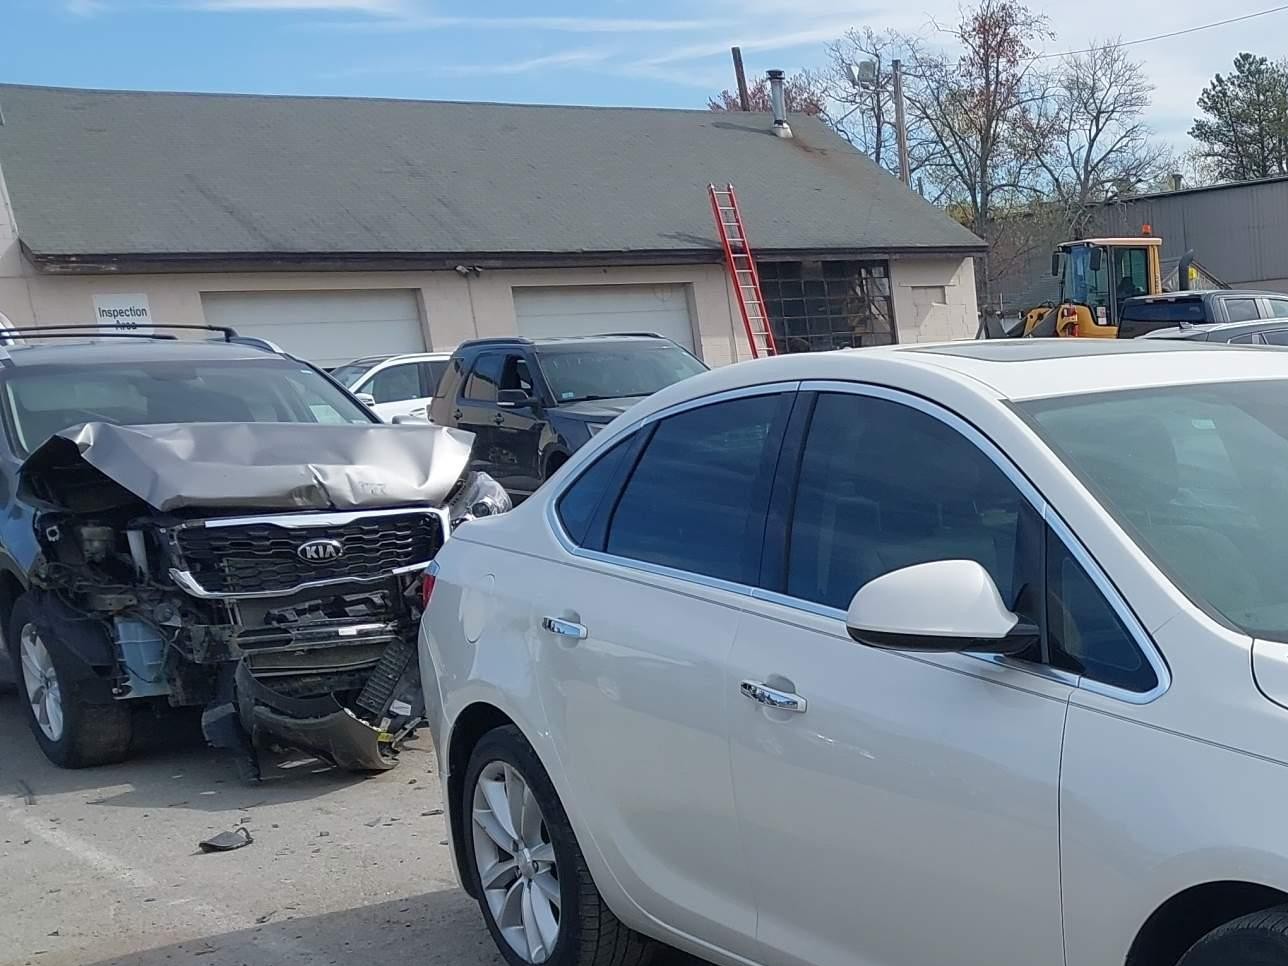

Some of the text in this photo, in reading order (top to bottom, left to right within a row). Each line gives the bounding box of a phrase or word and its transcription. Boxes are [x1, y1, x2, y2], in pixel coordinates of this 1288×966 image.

[98, 306, 148, 319] Inspection
[114, 320, 137, 331] Area
[305, 545, 337, 559] KIA
